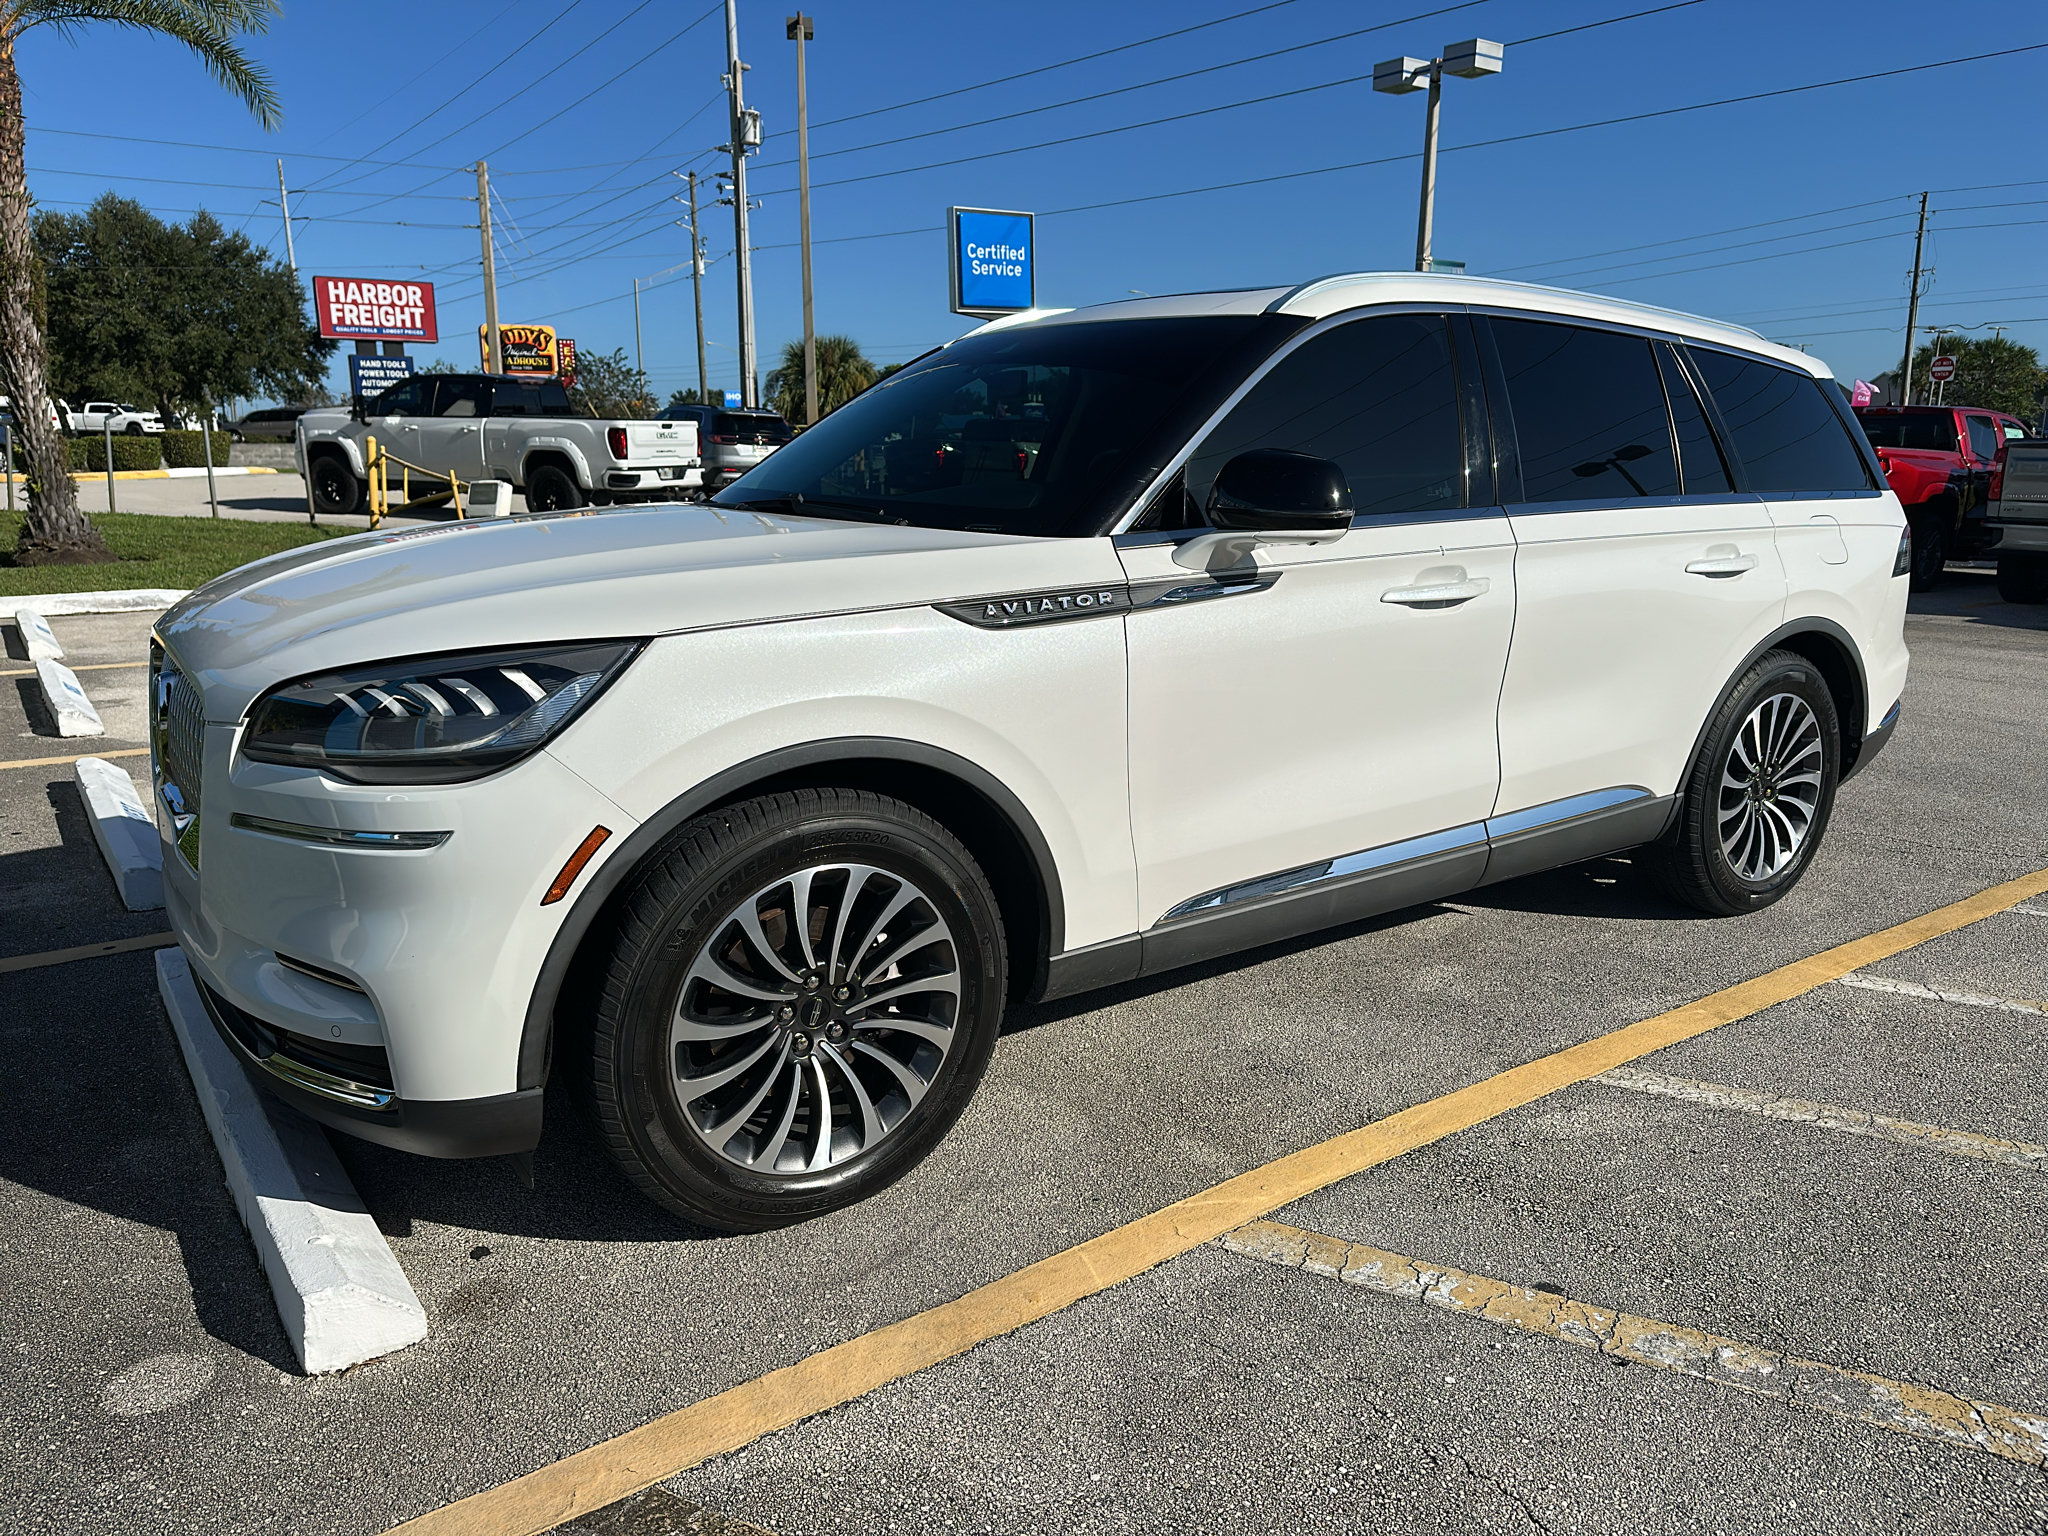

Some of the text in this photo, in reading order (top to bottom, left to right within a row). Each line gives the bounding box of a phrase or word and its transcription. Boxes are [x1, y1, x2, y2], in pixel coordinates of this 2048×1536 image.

[967, 243, 1025, 260] Certified
[972, 260, 1022, 277] Service
[327, 281, 423, 307] HARBOR
[329, 303, 425, 328] FREIGHT
[502, 328, 551, 351] ODY'S
[360, 360, 407, 368] HAND TOOLS
[506, 356, 549, 366] ADHOUSE
[358, 369, 410, 378] POWER TOOLS
[361, 379, 400, 387] AUTOMOT
[361, 388, 385, 396] GENE
[725, 392, 742, 401] IHO
[983, 591, 1114, 619] AVIATOR
